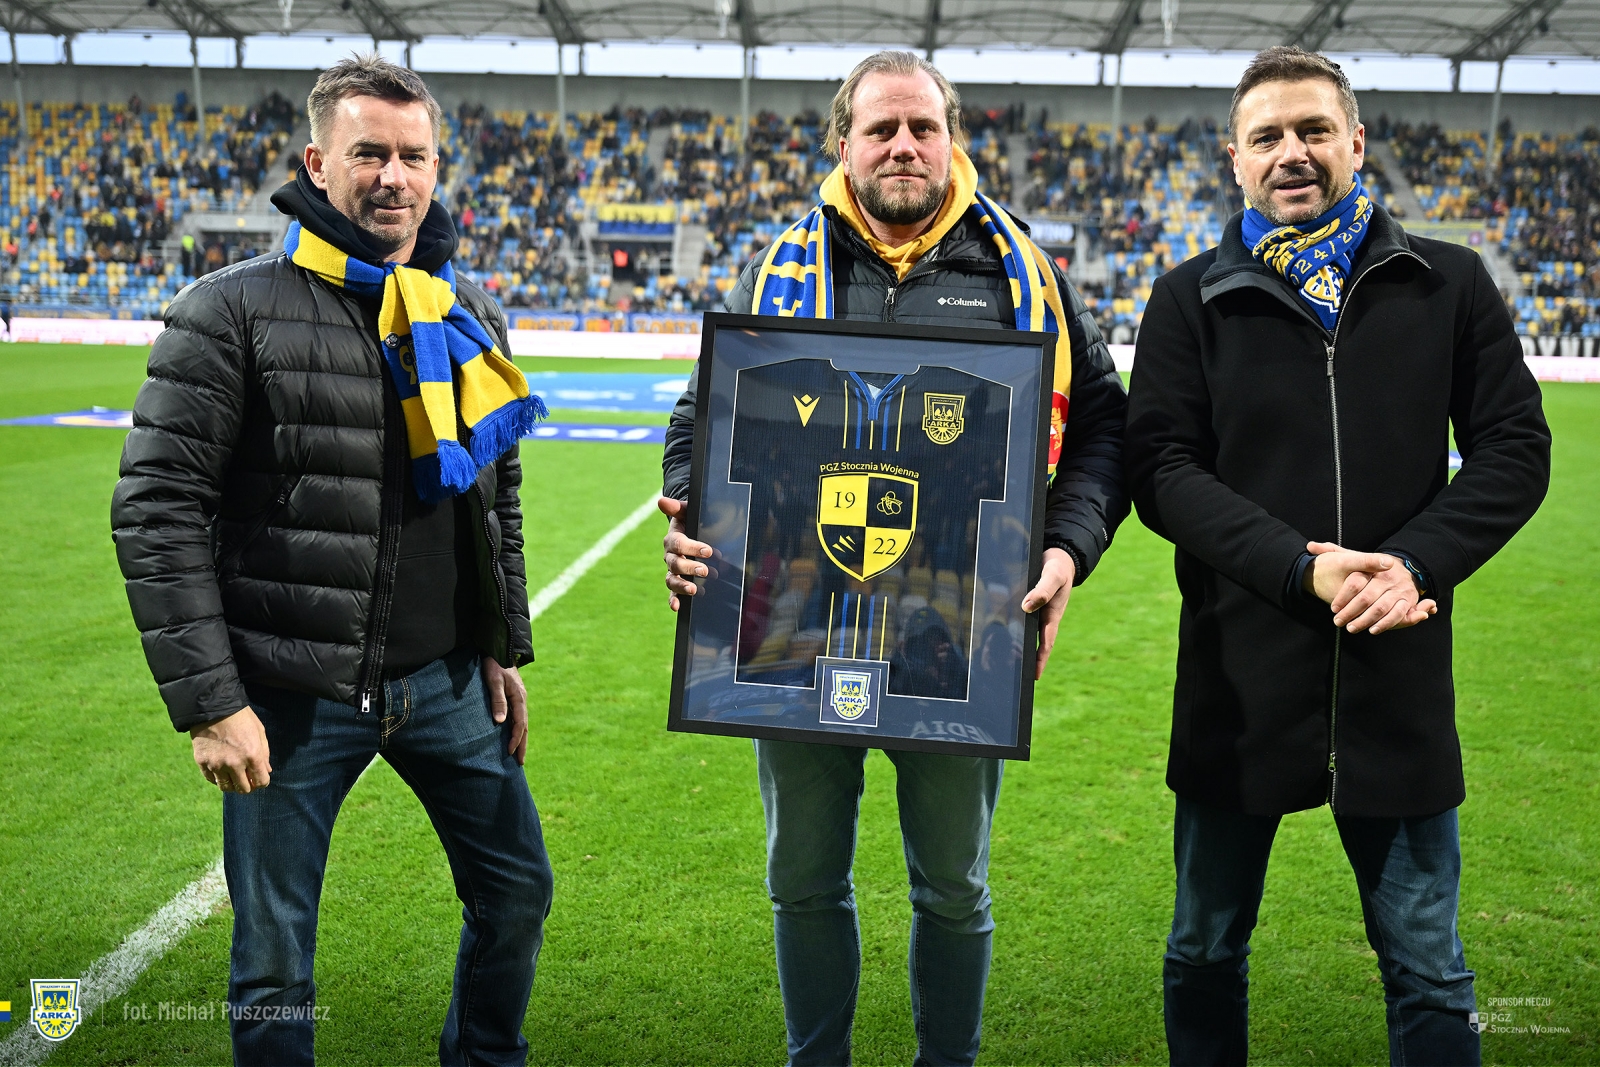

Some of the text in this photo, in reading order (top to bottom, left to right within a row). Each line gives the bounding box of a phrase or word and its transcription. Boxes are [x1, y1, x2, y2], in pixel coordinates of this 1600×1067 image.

[946, 297, 987, 307] Columbia
[930, 420, 957, 428] ARKA
[820, 461, 920, 479] PGZ Stocznia Wojenna
[834, 491, 856, 509] 19
[872, 537, 897, 556] 22
[837, 696, 863, 704] ARKA
